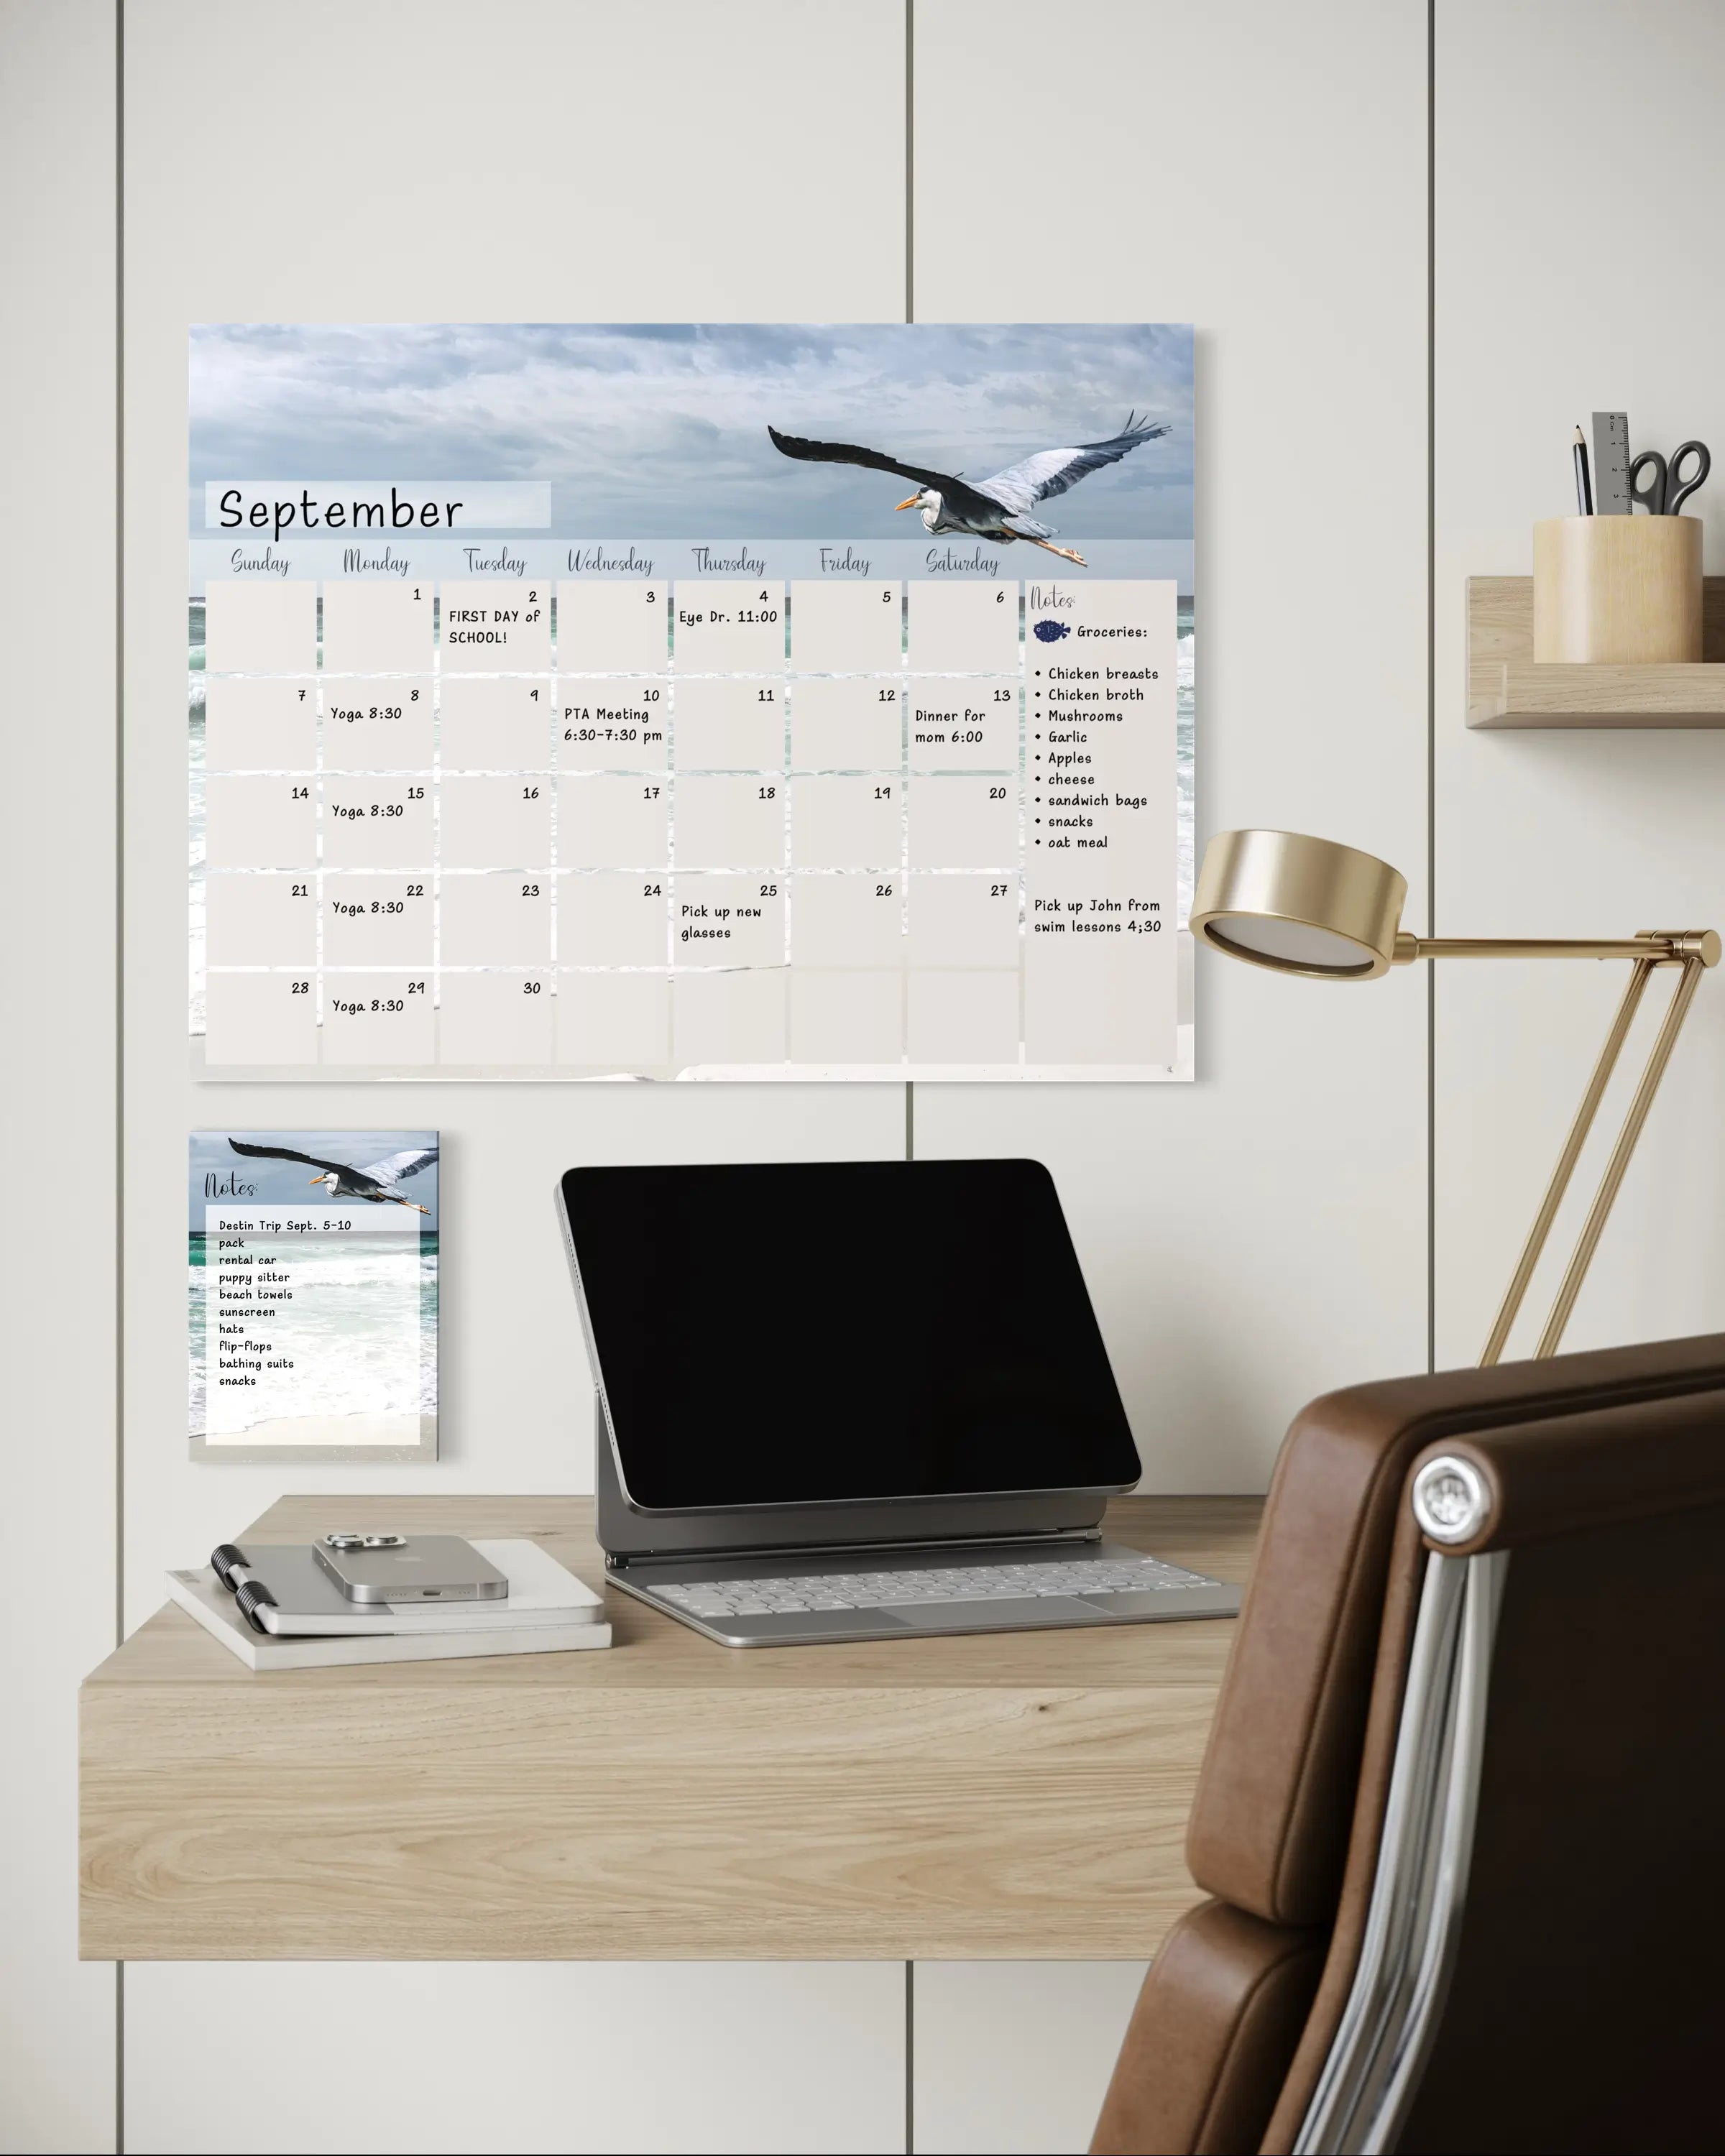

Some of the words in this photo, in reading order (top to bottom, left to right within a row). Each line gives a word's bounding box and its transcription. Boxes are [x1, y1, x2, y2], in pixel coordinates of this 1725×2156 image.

[219, 487, 464, 543] September
[231, 546, 292, 577] Sunday
[344, 546, 411, 577] Monday
[462, 545, 528, 577] Tuesday
[568, 545, 656, 577] Wednesday
[691, 546, 768, 577] Thursday
[819, 546, 873, 577] Friday
[926, 546, 1000, 577] Saturday
[413, 588, 421, 600] 1
[528, 591, 538, 603] 2
[646, 591, 656, 603] 3
[759, 590, 769, 602] 4
[882, 591, 891, 603] 5
[996, 591, 1005, 603] 6
[1031, 584, 1076, 610] Notes:
[449, 610, 487, 622] FIRST
[494, 610, 519, 622] DAY
[525, 609, 540, 622] of
[679, 610, 703, 627] Eye
[710, 610, 730, 622] Dr.
[737, 610, 778, 622] 11:00
[448, 631, 507, 644] SCHOOL!
[1077, 625, 1147, 637] Groceries:
[1049, 666, 1099, 680] Chicken
[1106, 666, 1159, 680] breasts
[298, 689, 306, 701] 7
[410, 689, 419, 701] 8
[530, 689, 538, 701] 9
[643, 689, 660, 701] 10
[758, 689, 775, 701] 11
[878, 689, 896, 701] 12
[993, 689, 1011, 701] 13
[1049, 688, 1099, 701] Chicken
[1106, 688, 1144, 701] broth
[331, 707, 364, 723] Yoga
[369, 706, 402, 719] 8:30
[565, 708, 589, 719] PTA
[597, 708, 649, 724] Meeting
[916, 709, 958, 722] Dinner
[965, 709, 986, 722] for
[1049, 709, 1123, 722] Mushrooms
[564, 729, 637, 741] 6:30-7:30
[643, 732, 662, 745] pm
[915, 734, 945, 742] mom
[951, 730, 983, 742] 6:00
[1049, 729, 1087, 742] Garlic
[1048, 751, 1092, 768] Apples
[1048, 772, 1095, 785] cheese
[292, 787, 309, 799] 14
[408, 787, 424, 799] 15
[523, 787, 539, 799] 16
[643, 787, 660, 799] 17
[758, 787, 776, 799] 18
[874, 787, 891, 799] 19
[989, 787, 1006, 799] 20
[1048, 793, 1108, 806] sandwich
[1116, 793, 1147, 810] bags
[332, 805, 366, 821] Yoga
[370, 804, 403, 816] 8:30
[1048, 814, 1093, 827] snacks
[1048, 836, 1071, 848] oat
[1077, 835, 1108, 848] meal
[292, 885, 308, 897] 21
[406, 885, 424, 897] 22
[522, 885, 540, 897] 23
[643, 885, 662, 897] 24
[760, 885, 777, 897] 25
[875, 885, 893, 897] 26
[990, 885, 1008, 897] 27
[332, 901, 366, 917] Yoga
[371, 901, 404, 913] 8:30
[681, 905, 708, 918] Pick
[714, 908, 730, 921] up
[737, 908, 761, 917] new
[1035, 898, 1061, 911] Pick
[1067, 903, 1083, 916] up
[1089, 898, 1121, 911] John
[1128, 898, 1160, 911] from
[1034, 921, 1065, 932] swim
[1072, 919, 1121, 932] lessons
[1127, 920, 1162, 934] 4;30
[681, 925, 731, 942] glasses
[292, 982, 309, 994] 28
[408, 982, 425, 994] 29
[523, 982, 540, 994] 30
[332, 1000, 366, 1015] Yoga
[371, 1000, 404, 1012] 8:30
[205, 1170, 259, 1199] Notes:
[219, 1220, 254, 1230] Destin
[259, 1220, 281, 1234] Trip
[286, 1220, 317, 1234] Sept.
[323, 1220, 351, 1230] 5-10
[219, 1237, 244, 1250] pack
[219, 1254, 253, 1265] rental
[219, 1275, 252, 1286] puppy
[257, 1272, 290, 1282] sitter
[219, 1289, 252, 1299] beach
[257, 1289, 293, 1299] towels
[219, 1323, 244, 1334] hats
[219, 1340, 272, 1354] flip-flops
[219, 1358, 262, 1371] bathing
[267, 1358, 294, 1368] suits
[219, 1375, 257, 1386] snacks
